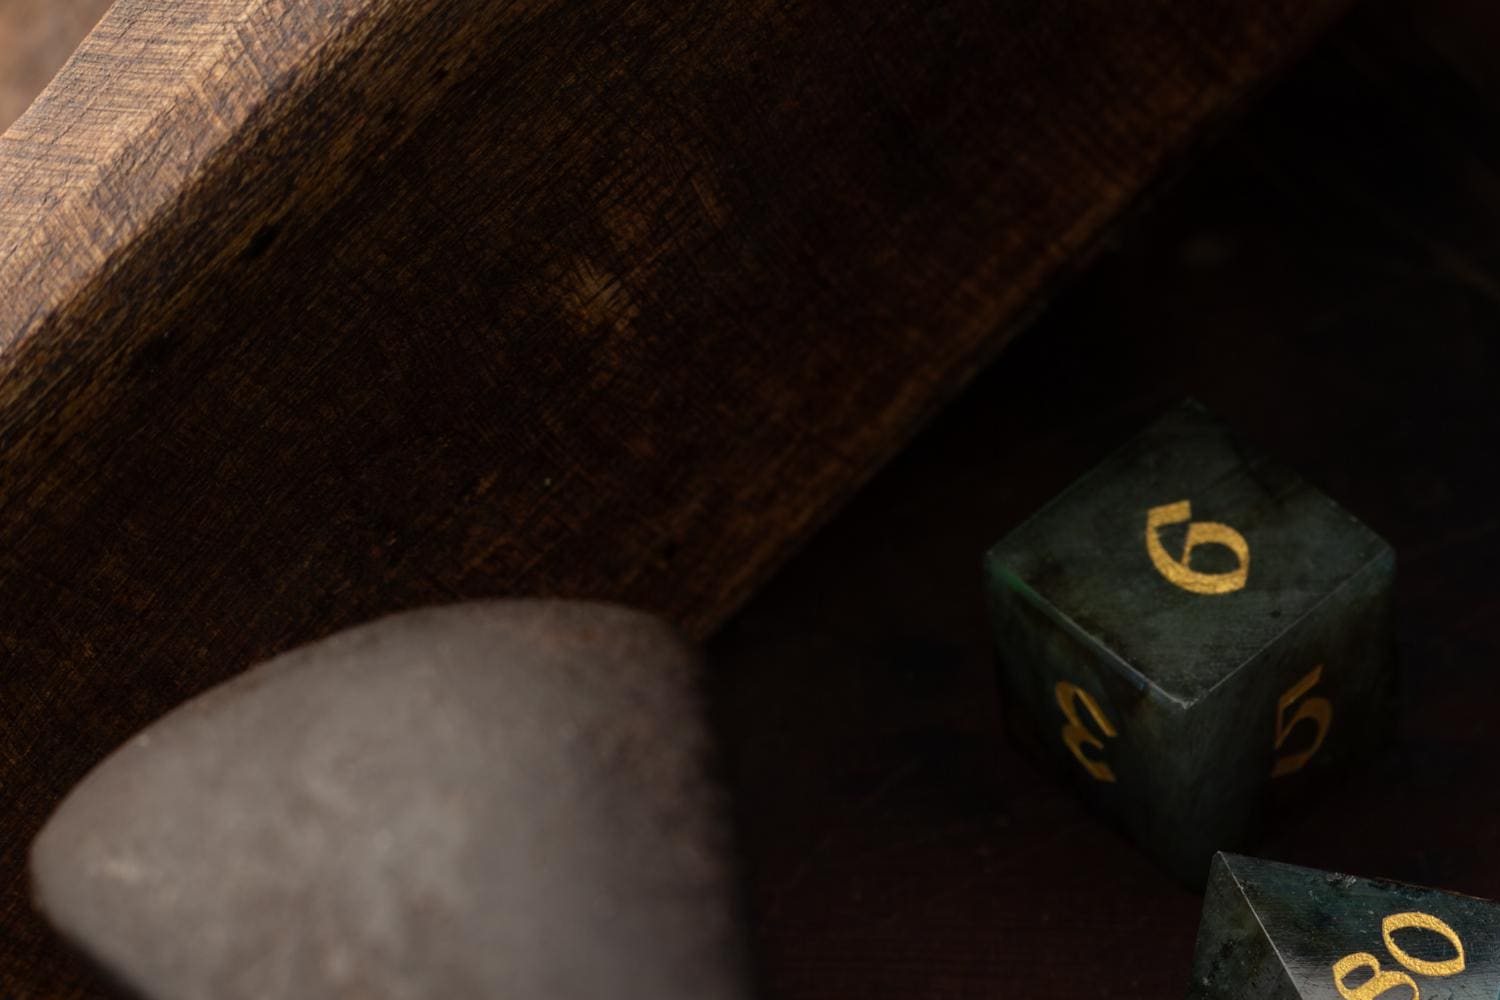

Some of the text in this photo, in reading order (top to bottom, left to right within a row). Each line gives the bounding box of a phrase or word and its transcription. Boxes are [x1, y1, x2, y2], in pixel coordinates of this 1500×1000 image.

[1146, 499, 1251, 595] 6
[1054, 680, 1119, 783] 3
[1271, 663, 1335, 780] 5
